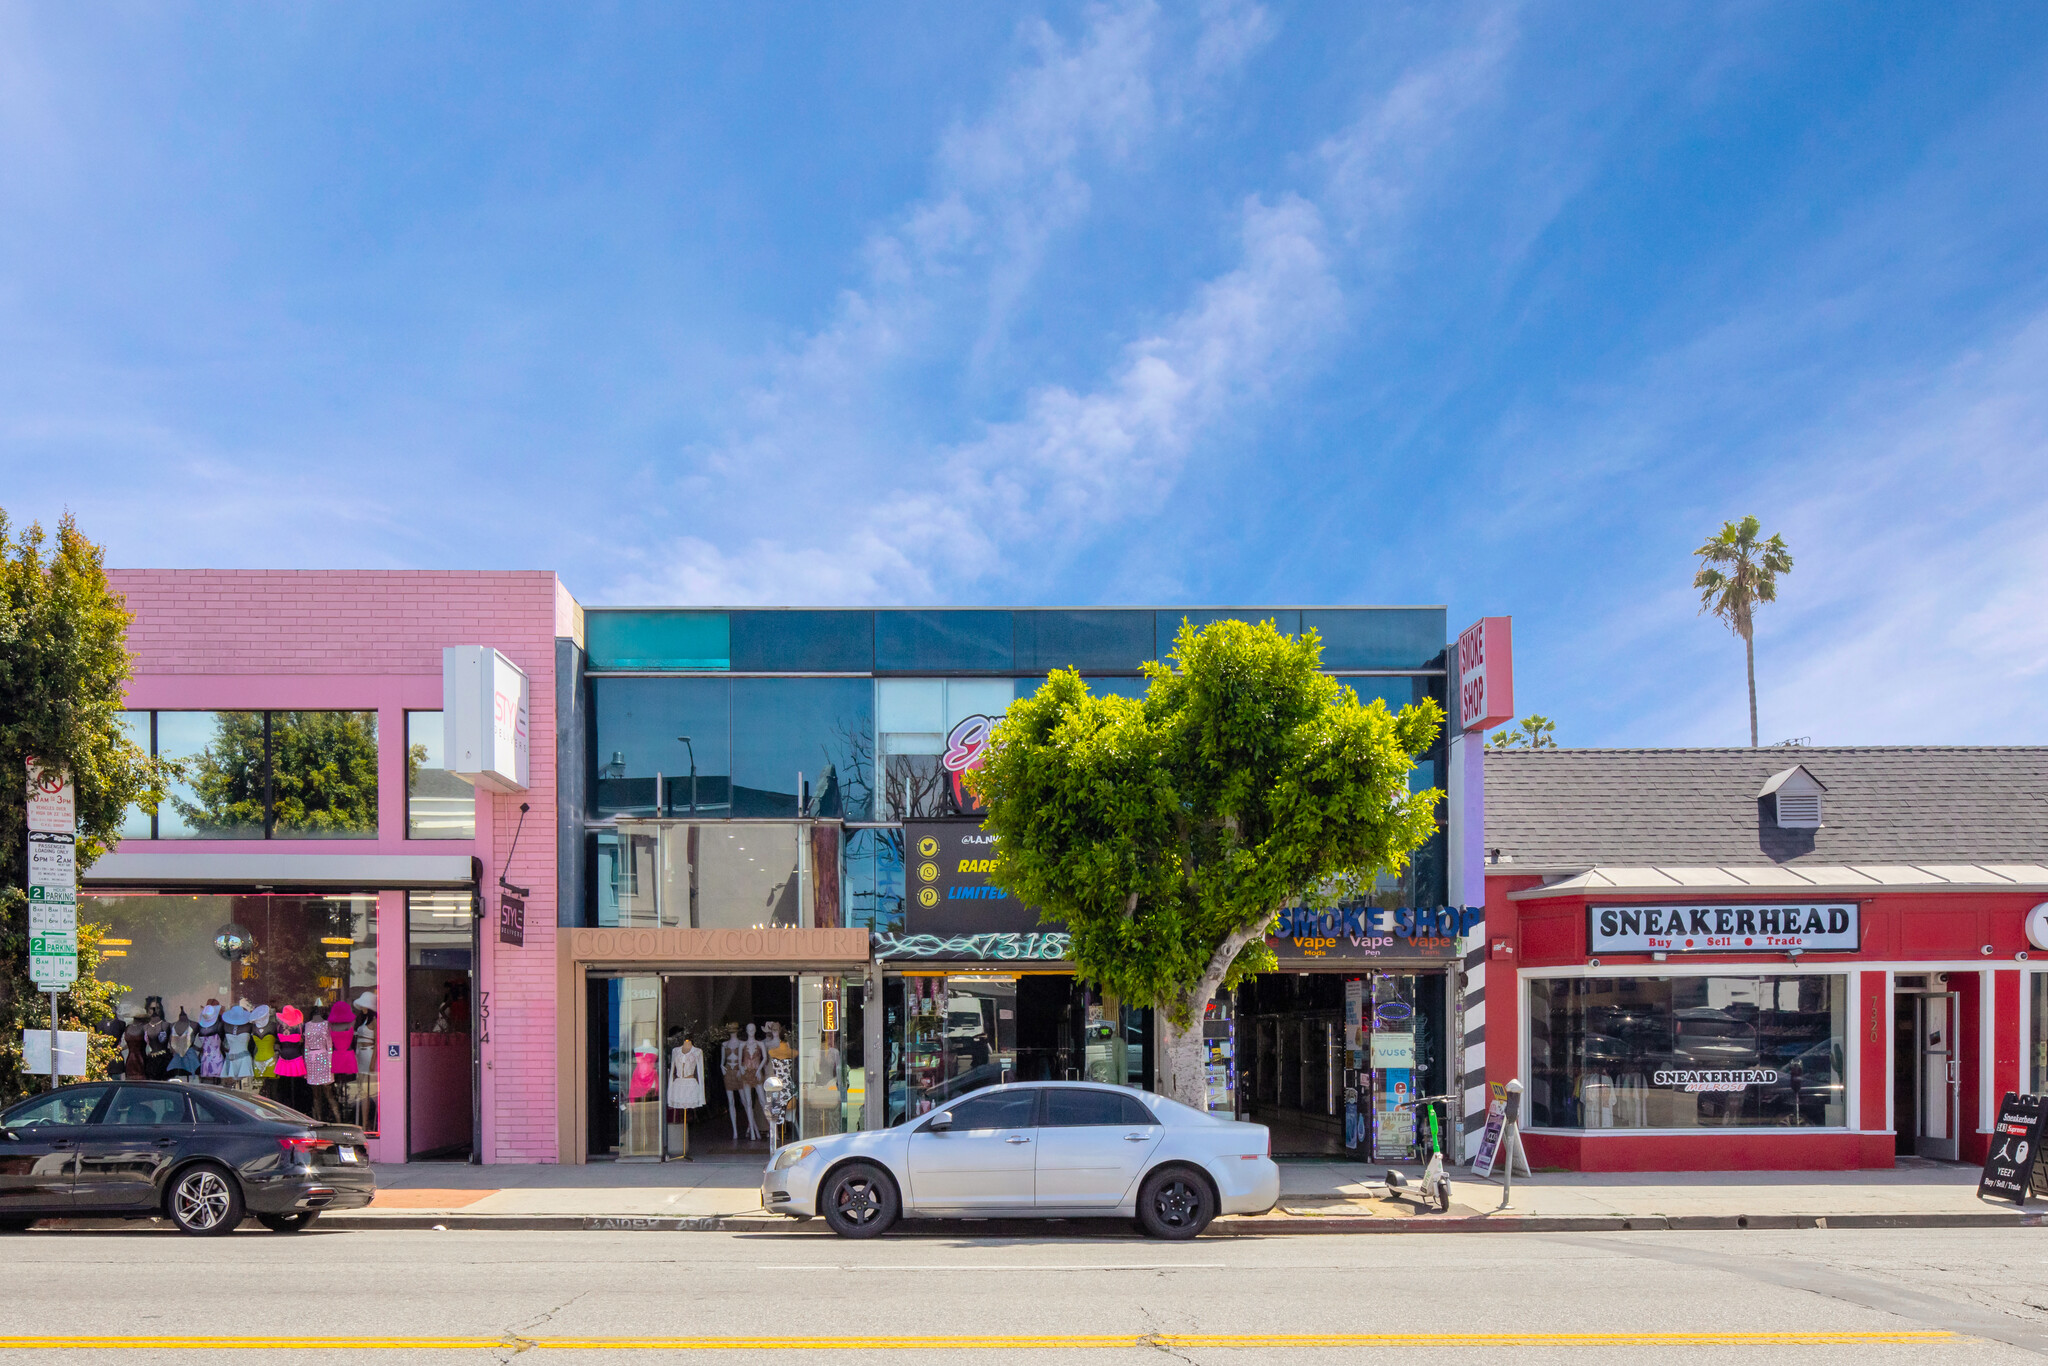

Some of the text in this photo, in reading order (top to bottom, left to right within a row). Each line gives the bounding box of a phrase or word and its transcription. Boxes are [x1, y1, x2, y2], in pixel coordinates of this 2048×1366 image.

[1462, 626, 1483, 675] SMOKE
[1464, 676, 1483, 722] SHOP
[33, 888, 41, 898] 2
[46, 892, 74, 901] PARKING
[502, 905, 523, 929] STYLE
[1275, 906, 1479, 938] SMOKE SHOP
[1600, 908, 1850, 936] SNEAKERHEAD
[35, 940, 42, 950] 2
[47, 944, 74, 952] PARKING
[573, 929, 868, 957] COCOLUX COUTURE
[1649, 937, 1802, 948] Buy Sell Trade
[480, 992, 490, 1044] 7314
[826, 1001, 834, 1031] OPEN
[1870, 995, 1878, 1043] 7320
[1379, 1049, 1406, 1057] vuse
[1655, 1070, 1777, 1084] SNEAKERHEAD
[1492, 1083, 1506, 1098] ATM
[1685, 1083, 1747, 1091] MELROSE
[2003, 1113, 2038, 1125] Sneakerhead
[1997, 1167, 2015, 1178] YEEZY
